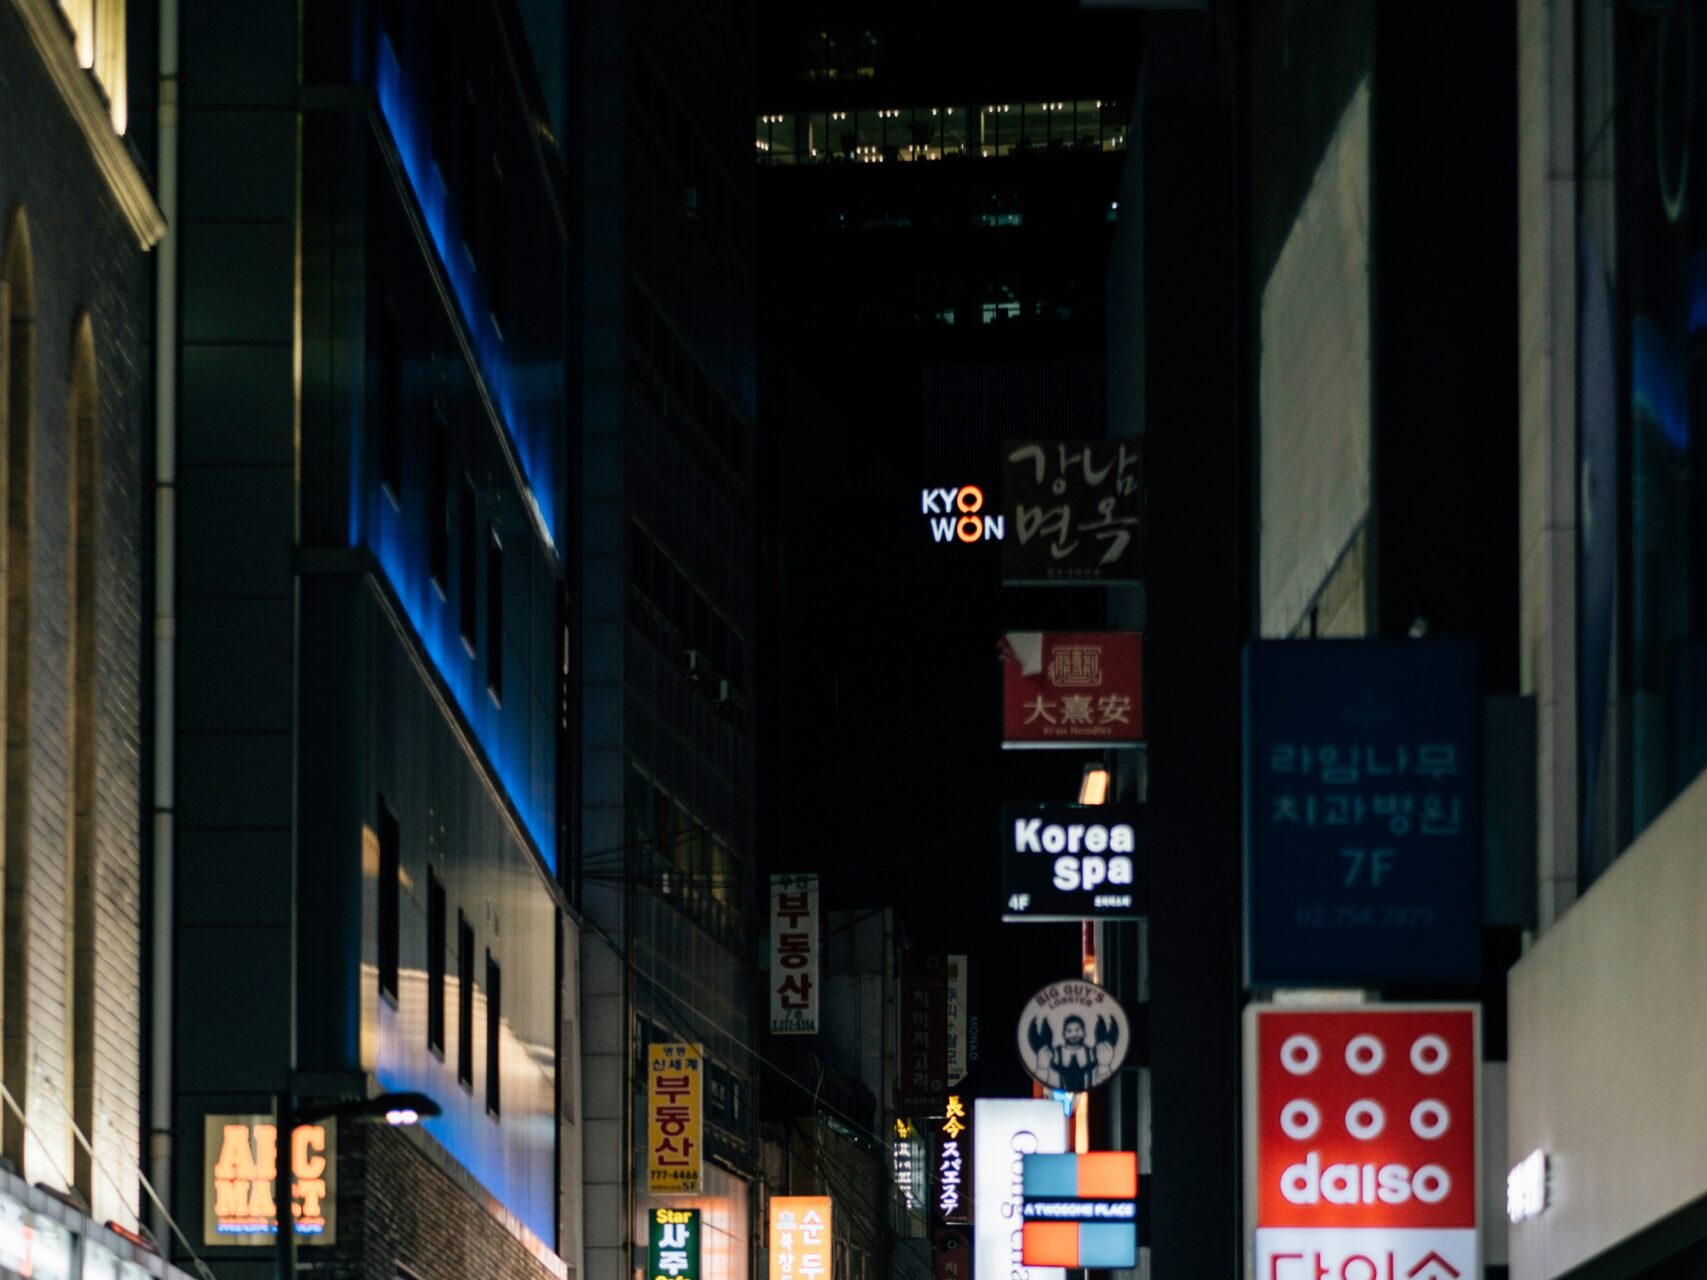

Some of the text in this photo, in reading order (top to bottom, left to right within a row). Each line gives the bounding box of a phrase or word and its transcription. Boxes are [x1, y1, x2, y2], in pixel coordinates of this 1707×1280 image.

[1008, 443, 1139, 497] 강남
[922, 484, 984, 514] KYO
[930, 514, 1005, 543] WON
[1016, 497, 1139, 567] 면옥
[1014, 818, 1134, 853] Korea
[1269, 794, 1462, 836] 치과병원
[1338, 848, 1397, 888] 7F
[1008, 893, 1030, 911] 4F
[777, 891, 813, 1010] 부동산
[968, 1015, 980, 1061] MONAD
[656, 1075, 693, 1166] 부동산
[1279, 1151, 1451, 1205] daiso
[656, 1208, 693, 1223] Star
[1095, 1203, 1135, 1217] PLACE
[658, 1223, 691, 1276] 사주
